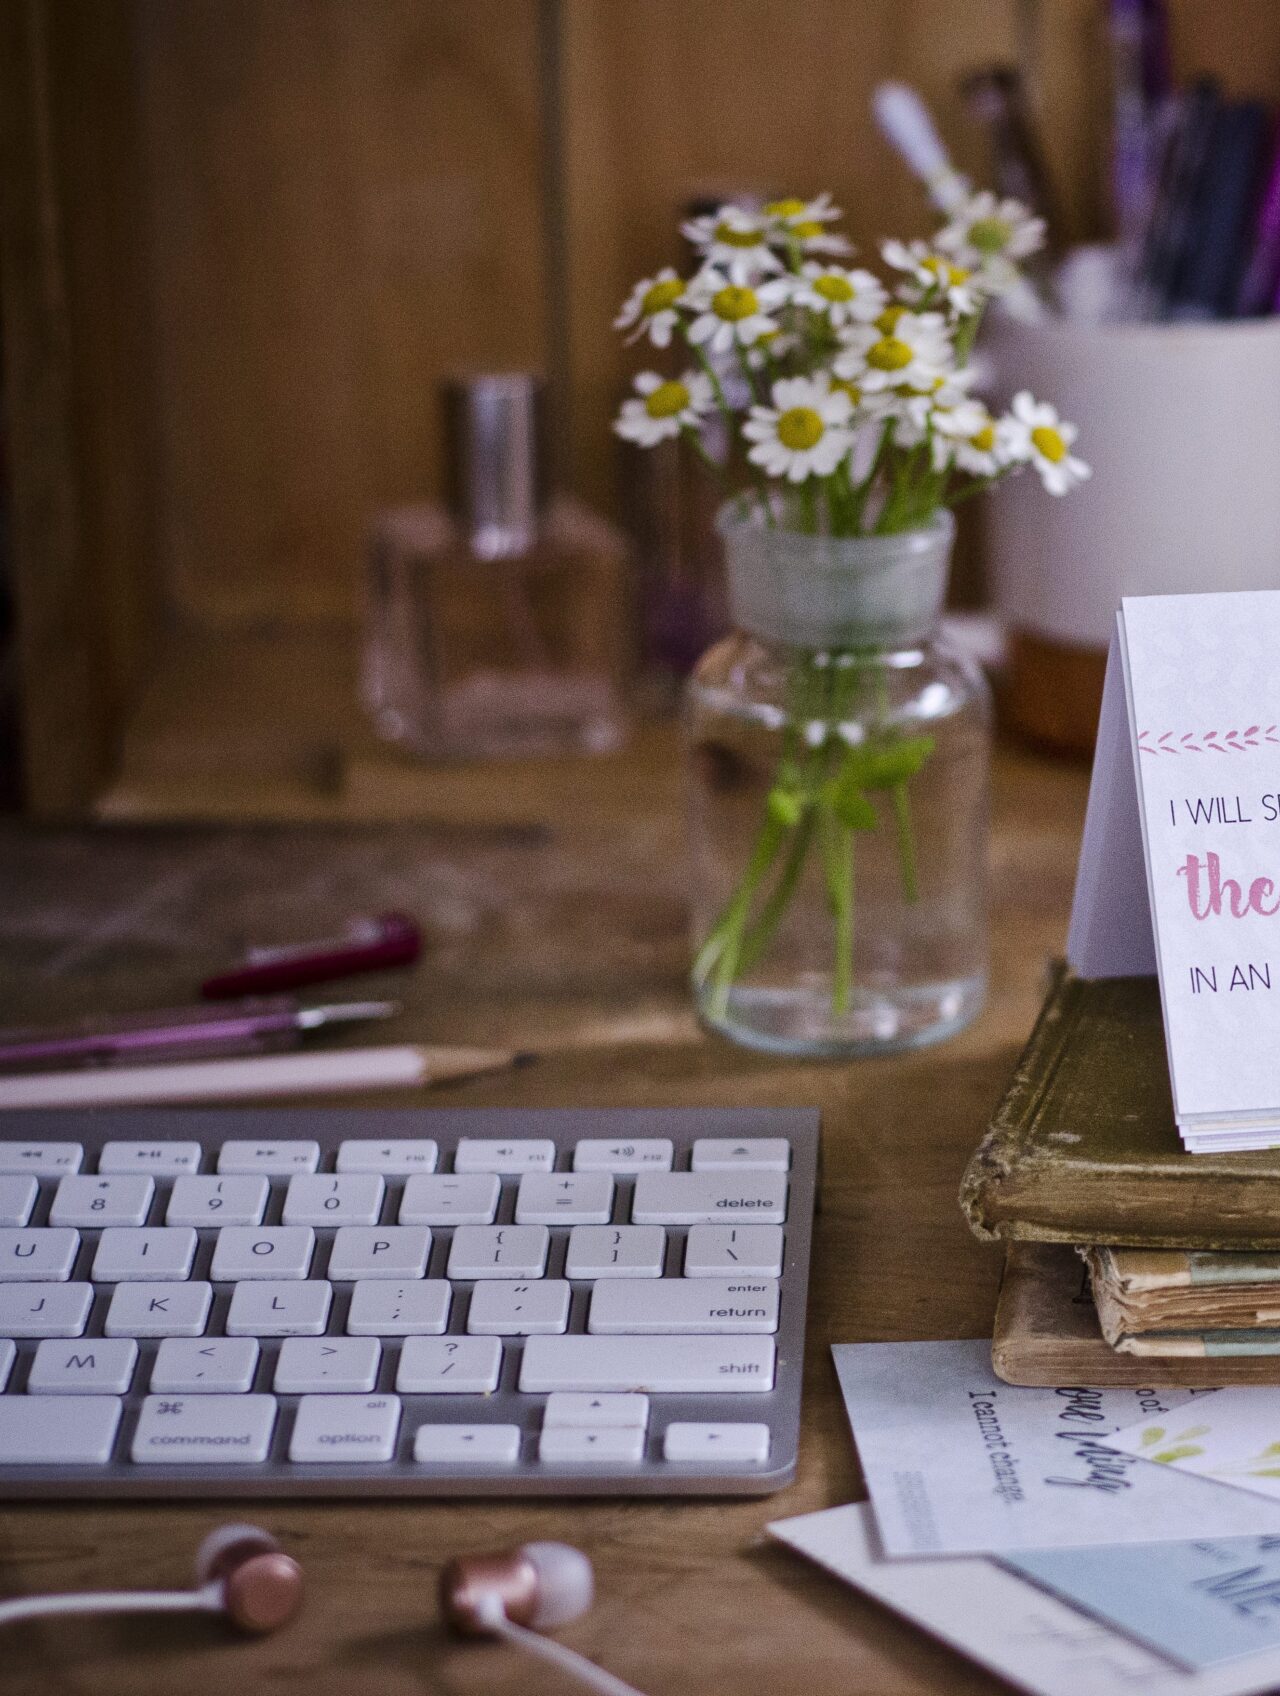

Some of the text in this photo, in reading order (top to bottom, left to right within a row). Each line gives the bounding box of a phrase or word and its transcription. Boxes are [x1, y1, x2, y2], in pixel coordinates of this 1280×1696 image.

[1170, 800, 1176, 826] I
[1185, 796, 1252, 824] WILL
[1190, 966, 1217, 993] IN
[1230, 963, 1271, 991] AN
[91, 1199, 105, 1210] 8
[209, 1200, 222, 1210] 9
[716, 1199, 772, 1207] delete
[15, 1244, 36, 1256] U
[142, 1243, 148, 1255] I
[252, 1242, 274, 1254] O
[373, 1242, 390, 1254] P
[31, 1299, 45, 1311] J
[150, 1299, 168, 1311] K
[272, 1297, 284, 1309] L
[710, 1308, 765, 1316] return
[66, 1355, 95, 1368] M
[719, 1363, 760, 1373] shift
[366, 1400, 387, 1409] alt
[972, 1401, 1012, 1449] cannot
[150, 1436, 250, 1445] command
[319, 1435, 380, 1445] option
